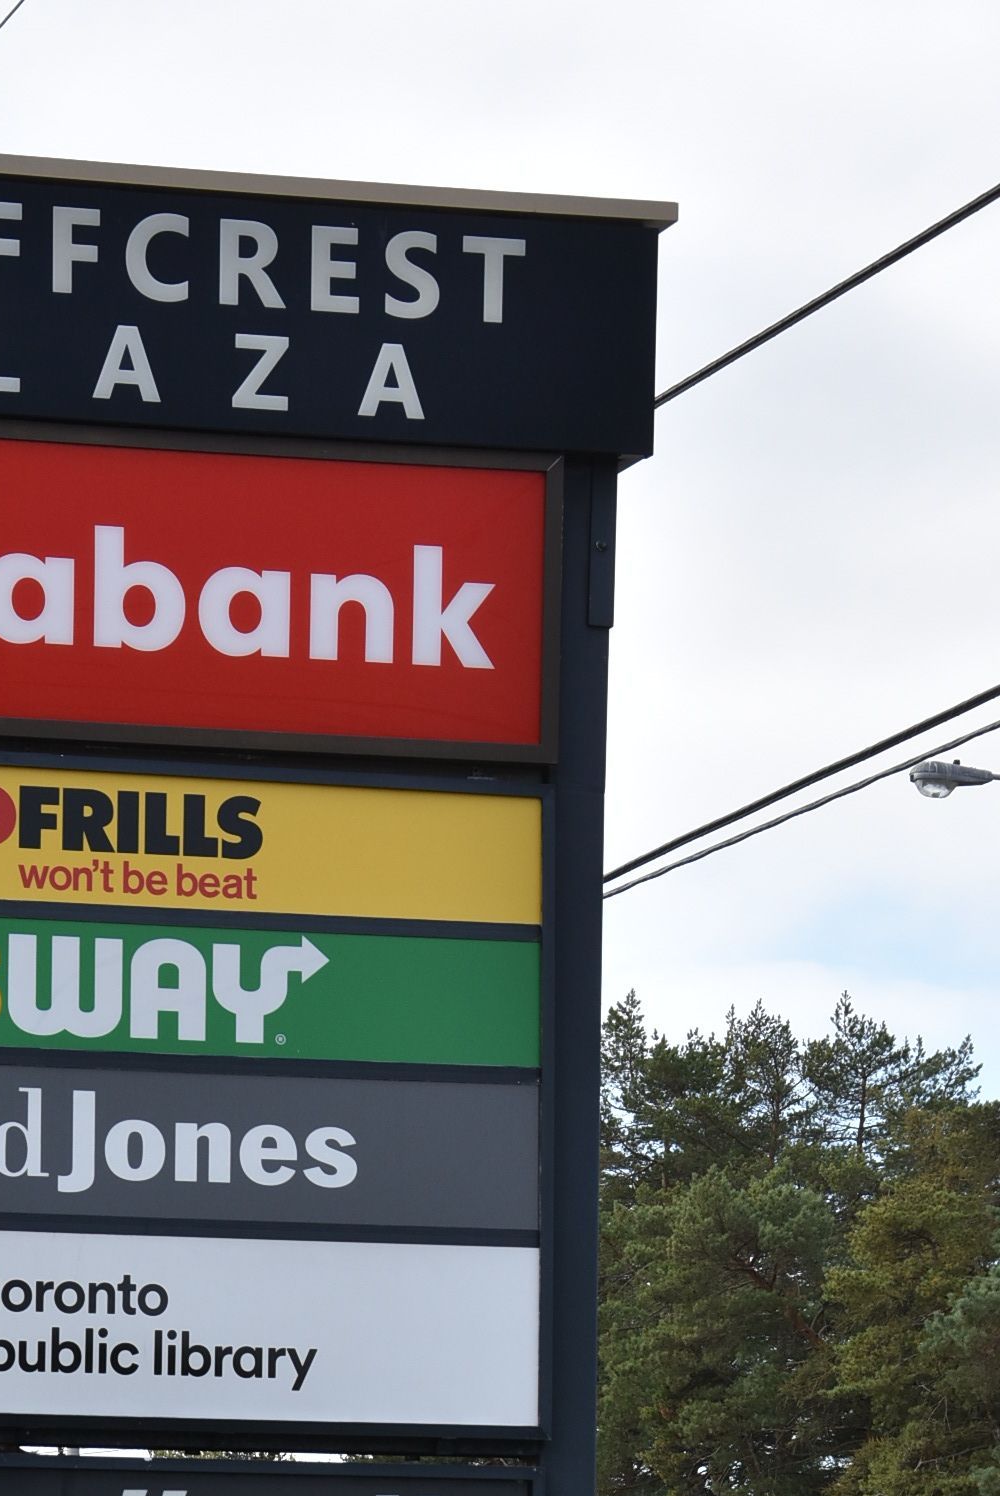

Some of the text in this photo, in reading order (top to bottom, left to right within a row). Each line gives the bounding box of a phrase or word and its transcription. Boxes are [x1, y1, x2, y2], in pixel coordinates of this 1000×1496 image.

[18, 859, 257, 900] won't be beat
[154, 1330, 318, 1391] library
